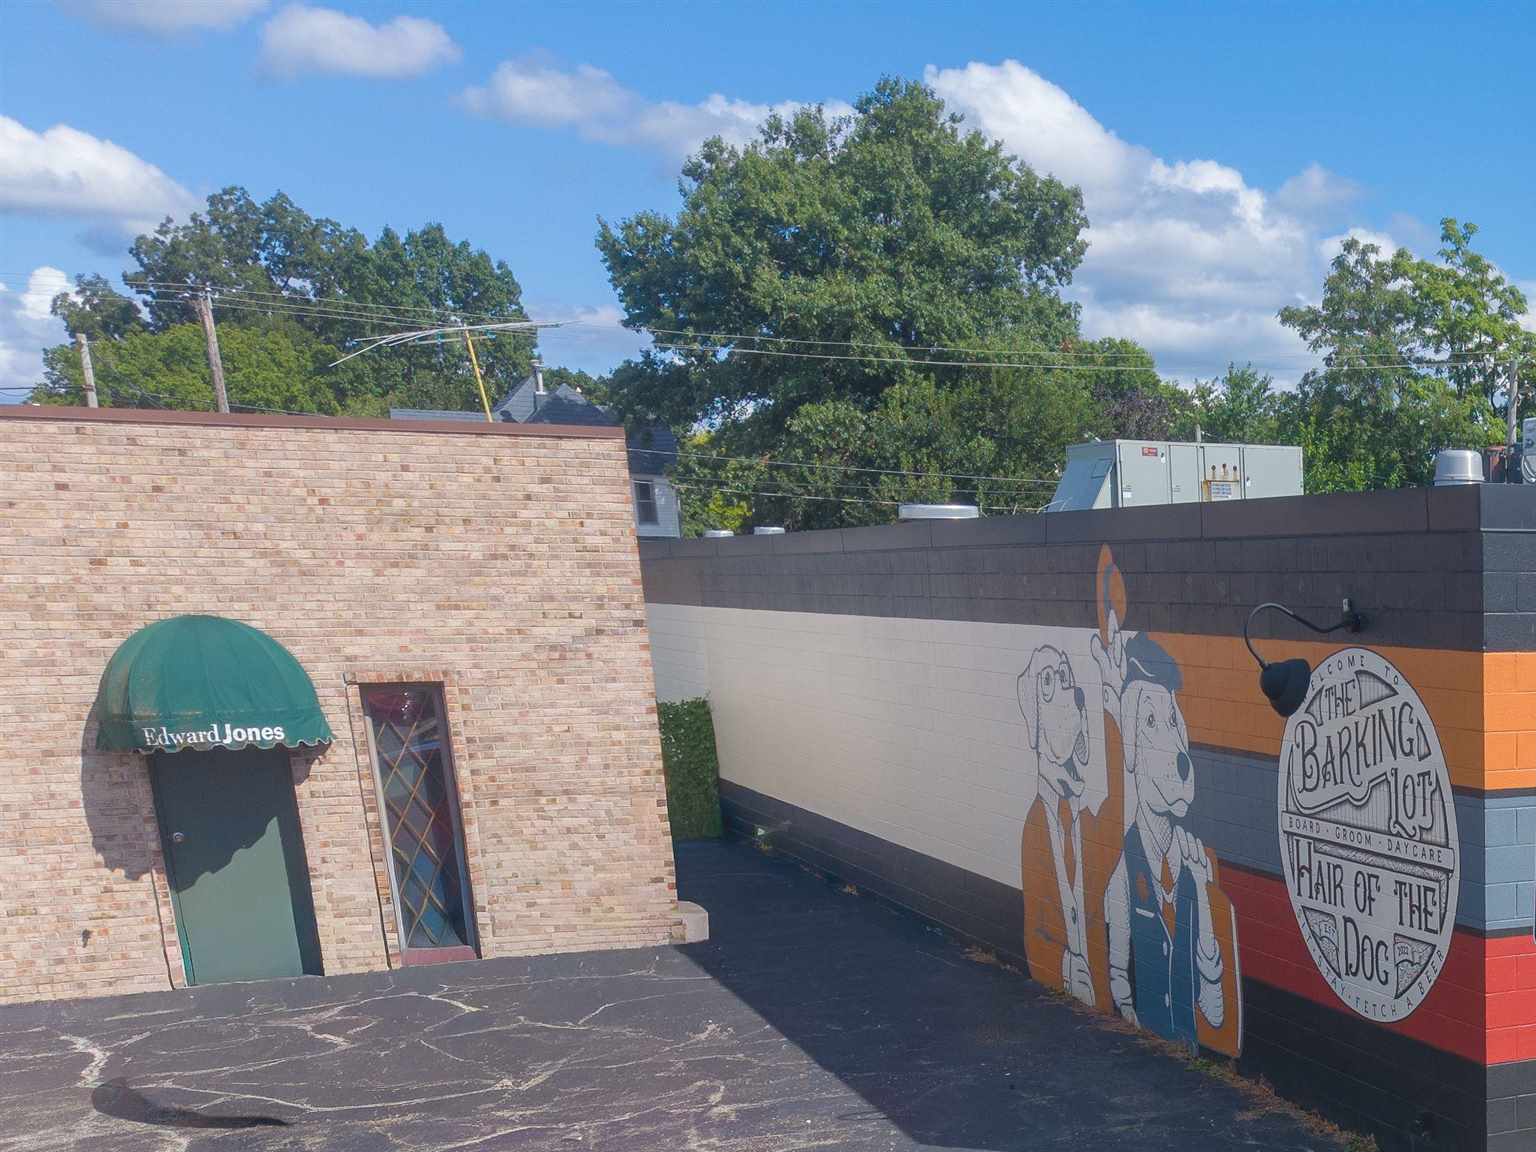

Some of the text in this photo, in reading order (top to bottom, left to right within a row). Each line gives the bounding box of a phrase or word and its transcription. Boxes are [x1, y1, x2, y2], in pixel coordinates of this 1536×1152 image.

[1306, 655, 1399, 695] ELCOME TO
[1324, 678, 1357, 721] THE
[142, 723, 286, 746] Edward Jones
[1294, 701, 1415, 793] BARKING
[1390, 767, 1433, 838] LOT
[1288, 816, 1443, 864] BOARD GROOM DAYCARE
[1296, 838, 1439, 935] HAIR OF THE
[1316, 954, 1347, 997] STAY
[1418, 949, 1445, 996] BEER
[1342, 915, 1389, 987] DOG
